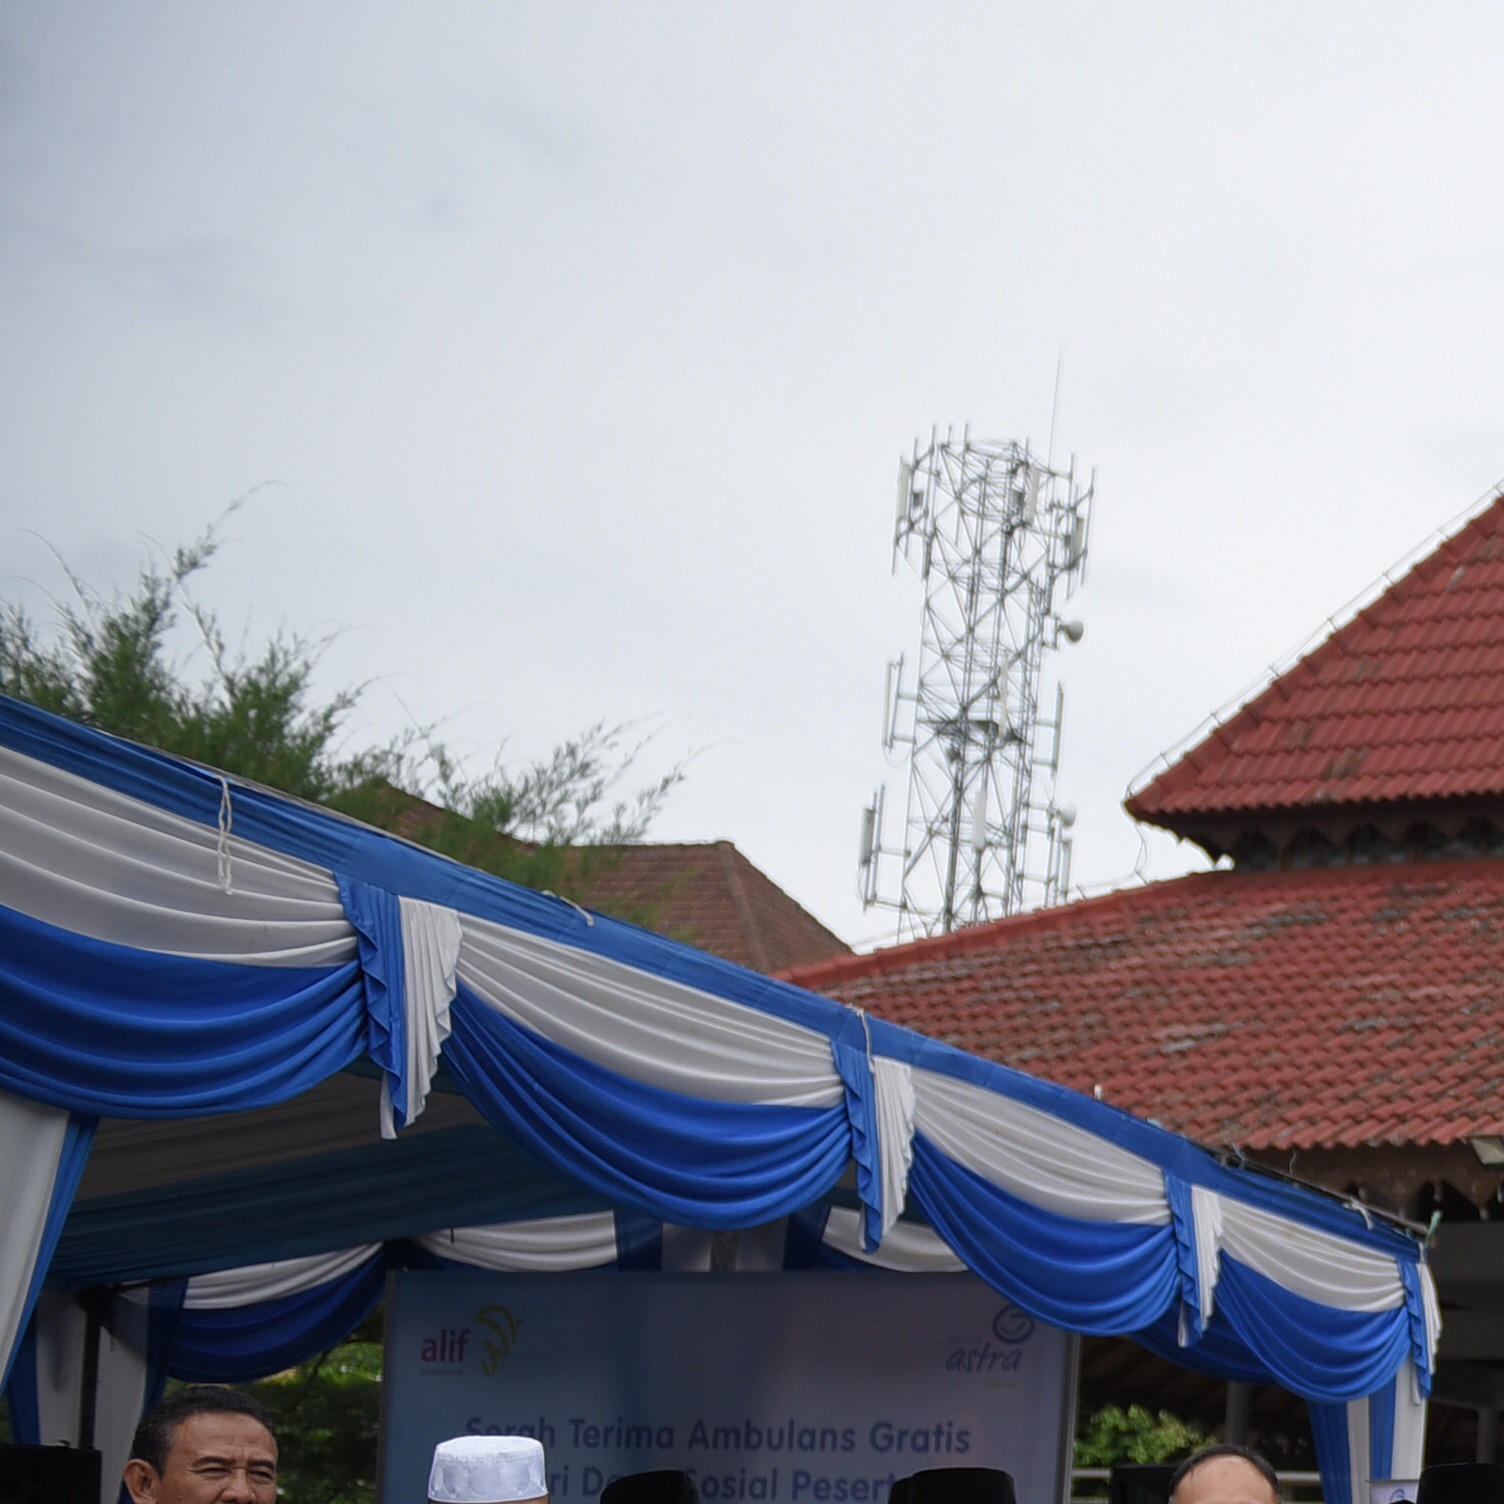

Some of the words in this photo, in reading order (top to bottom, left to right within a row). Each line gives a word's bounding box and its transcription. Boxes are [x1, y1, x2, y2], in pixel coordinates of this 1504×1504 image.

[421, 1328, 471, 1363] alif
[945, 1342, 1023, 1373] astra
[569, 1417, 674, 1449] Terima
[687, 1418, 856, 1453] Ambulans
[869, 1421, 971, 1454] Gratis
[690, 1467, 779, 1502] osial
[791, 1469, 898, 1503] Pesert
